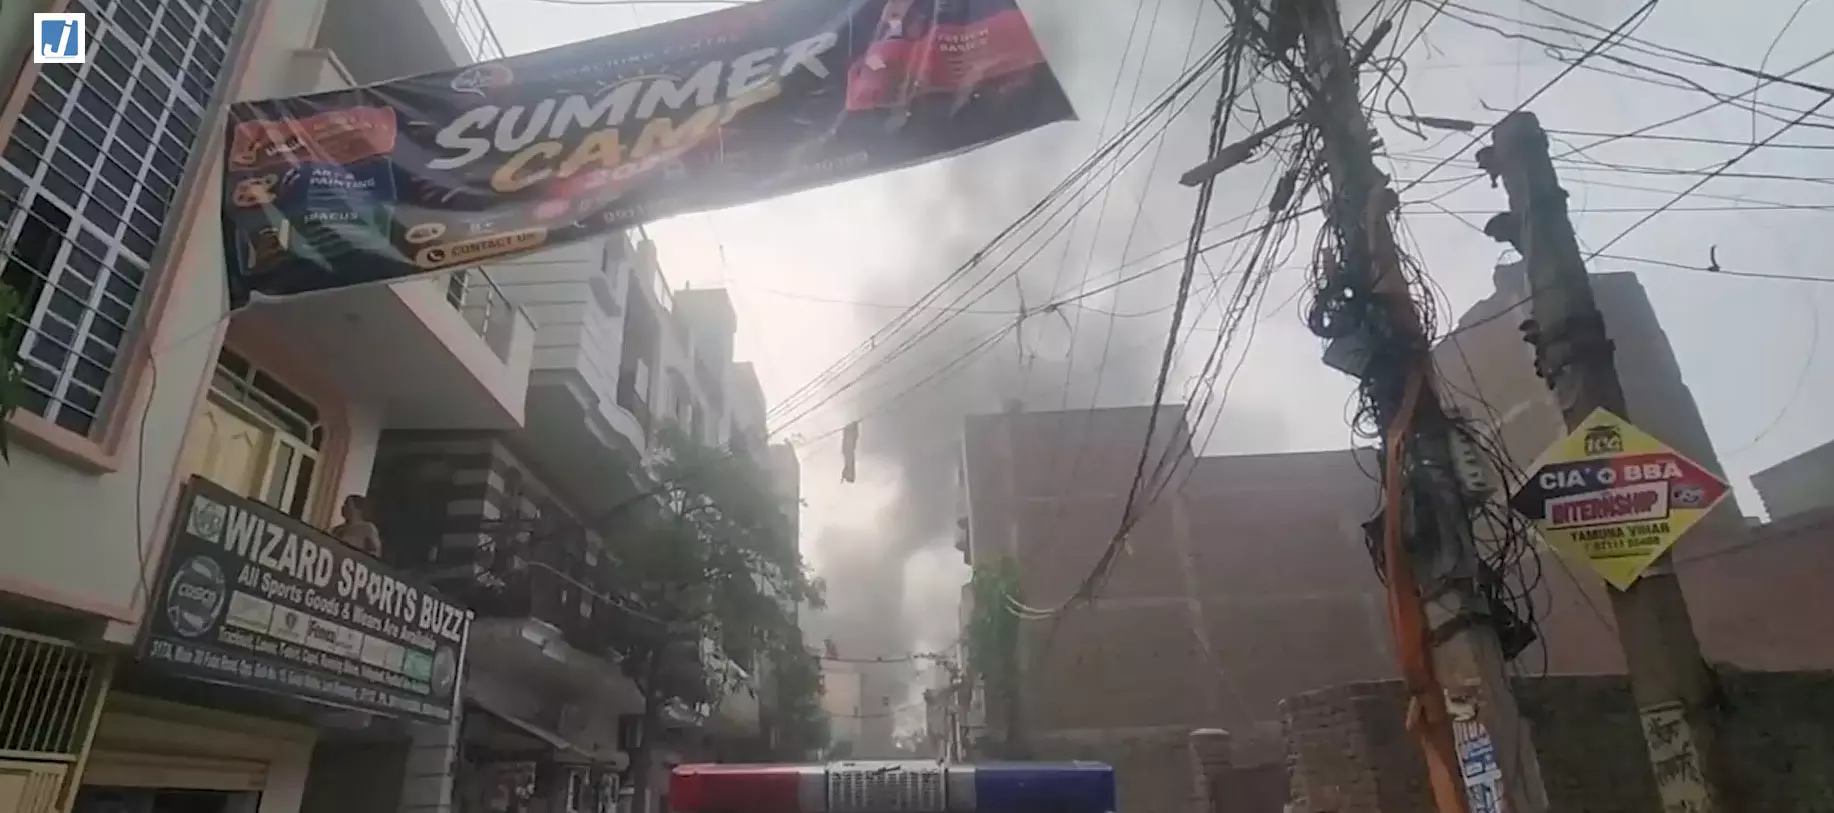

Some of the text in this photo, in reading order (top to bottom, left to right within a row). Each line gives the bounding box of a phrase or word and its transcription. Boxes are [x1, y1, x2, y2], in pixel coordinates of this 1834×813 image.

[426, 32, 838, 170] SUMMER
[491, 82, 781, 193] CAMP
[309, 176, 376, 190] PAINTING
[451, 236, 512, 257] CONTACT
[1624, 460, 1683, 482] BBA
[1551, 490, 1658, 525] INTERNSHIP
[1570, 526, 1626, 542] YAMUNA
[1629, 522, 1671, 537] VIHAR
[223, 505, 334, 588] WIZARD
[337, 557, 418, 623] SPORTS
[419, 593, 465, 643] BUZZ
[237, 564, 260, 588] All
[261, 572, 303, 605] Sports
[304, 588, 340, 617] Goods
[340, 601, 351, 620] &
